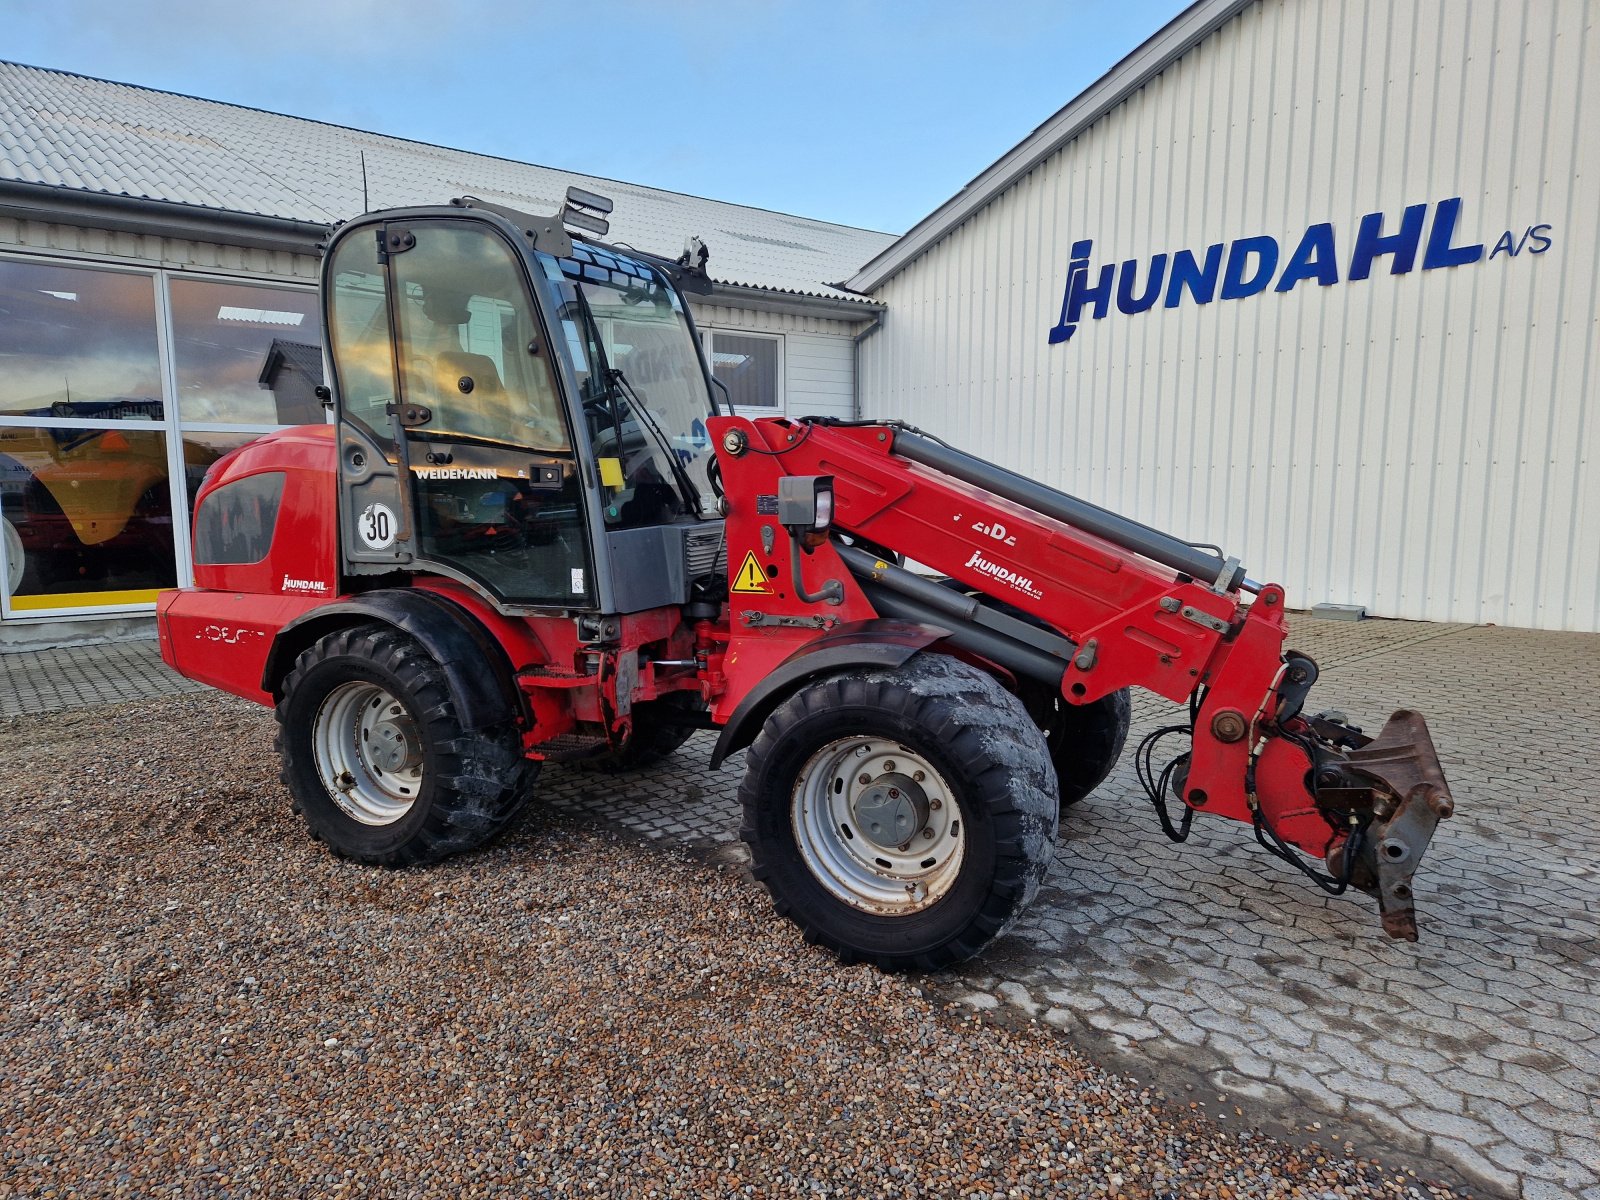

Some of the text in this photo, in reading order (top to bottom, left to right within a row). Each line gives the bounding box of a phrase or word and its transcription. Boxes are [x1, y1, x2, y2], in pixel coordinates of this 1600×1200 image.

[1488, 224, 1552, 260] A/S
[415, 468, 498, 480] WEIDEMANN
[365, 511, 389, 541] 30
